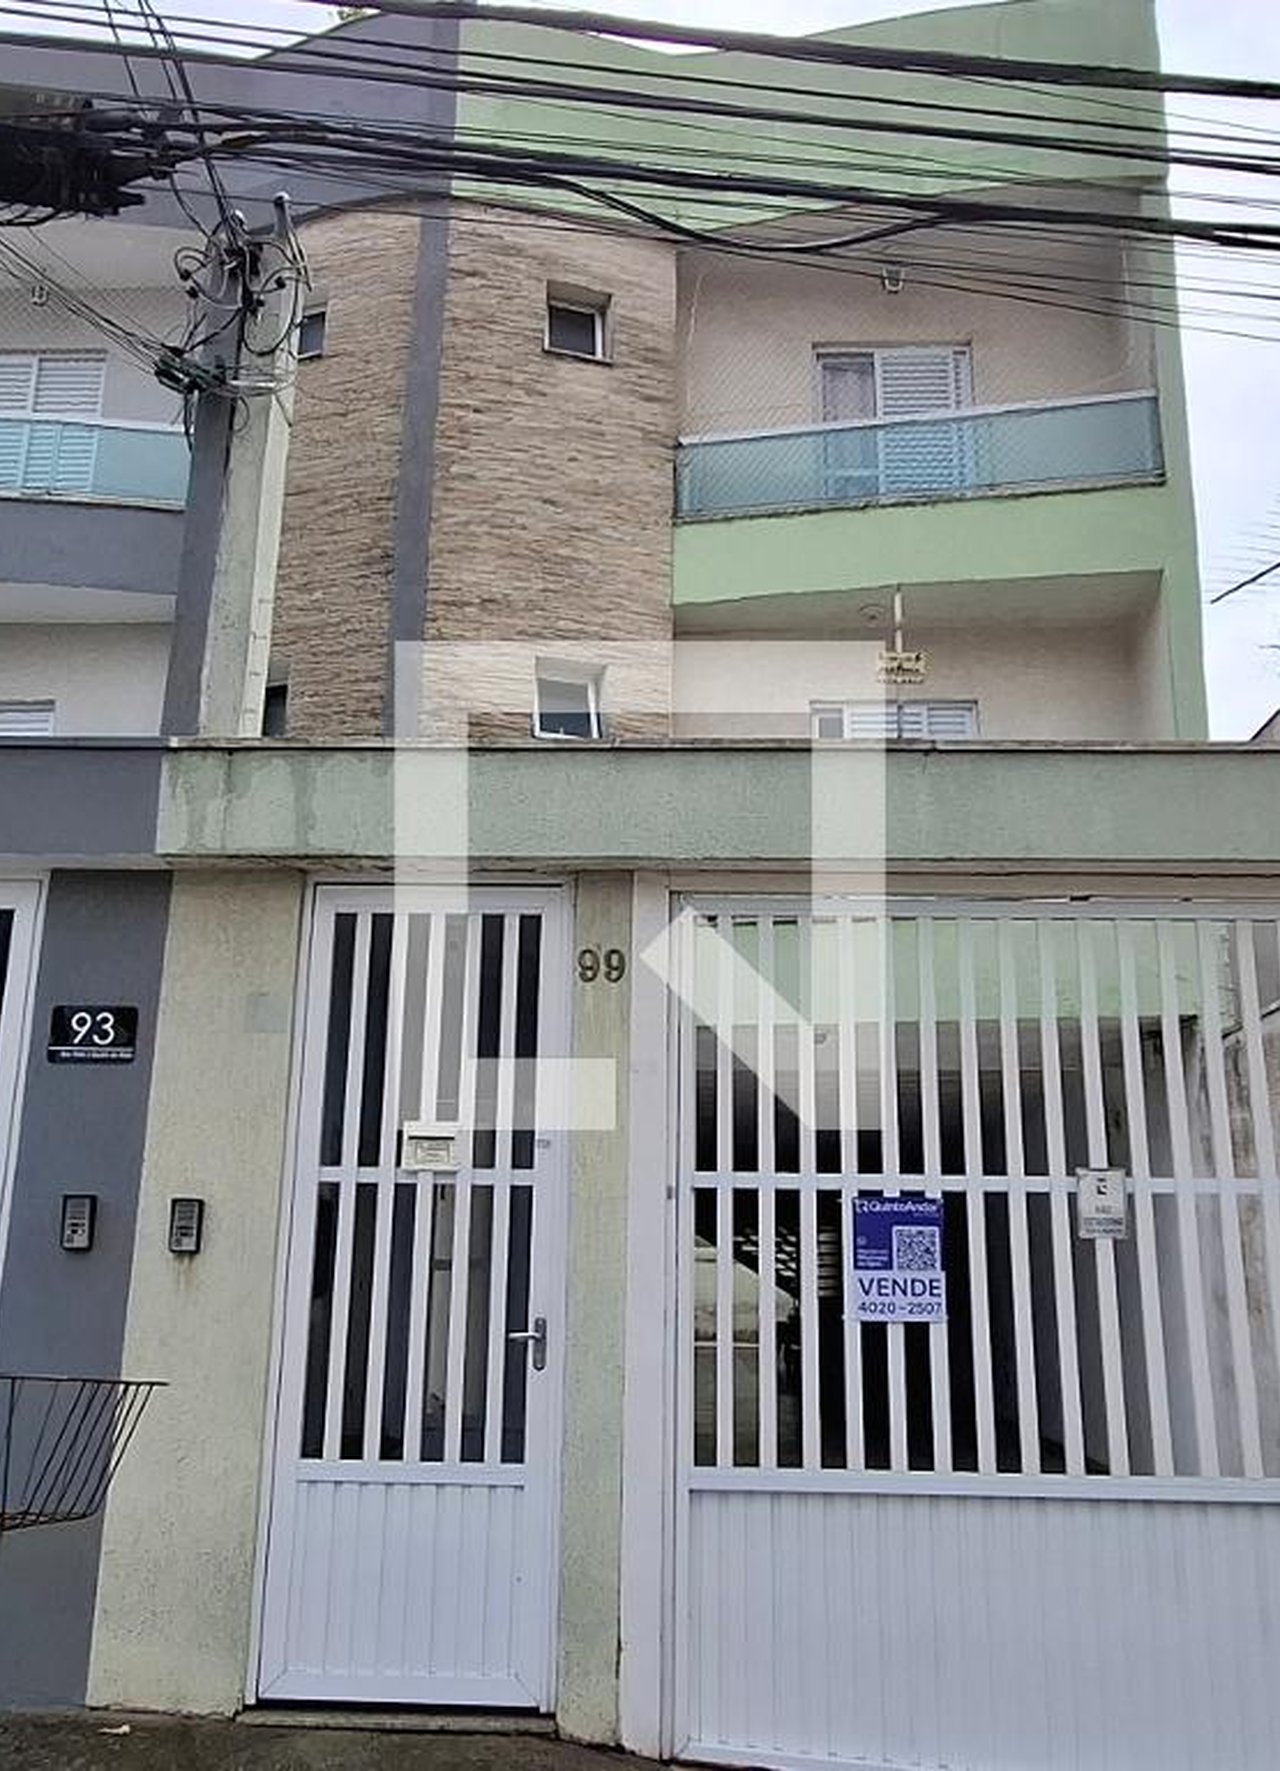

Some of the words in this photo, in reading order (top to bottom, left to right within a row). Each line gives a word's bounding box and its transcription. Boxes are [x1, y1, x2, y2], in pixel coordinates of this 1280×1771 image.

[578, 948, 626, 983] 99
[70, 1011, 116, 1046] 93
[869, 1199, 938, 1213] QuintoAndar
[858, 1277, 942, 1298] VENDE
[857, 1301, 942, 1315] 4020-2507
